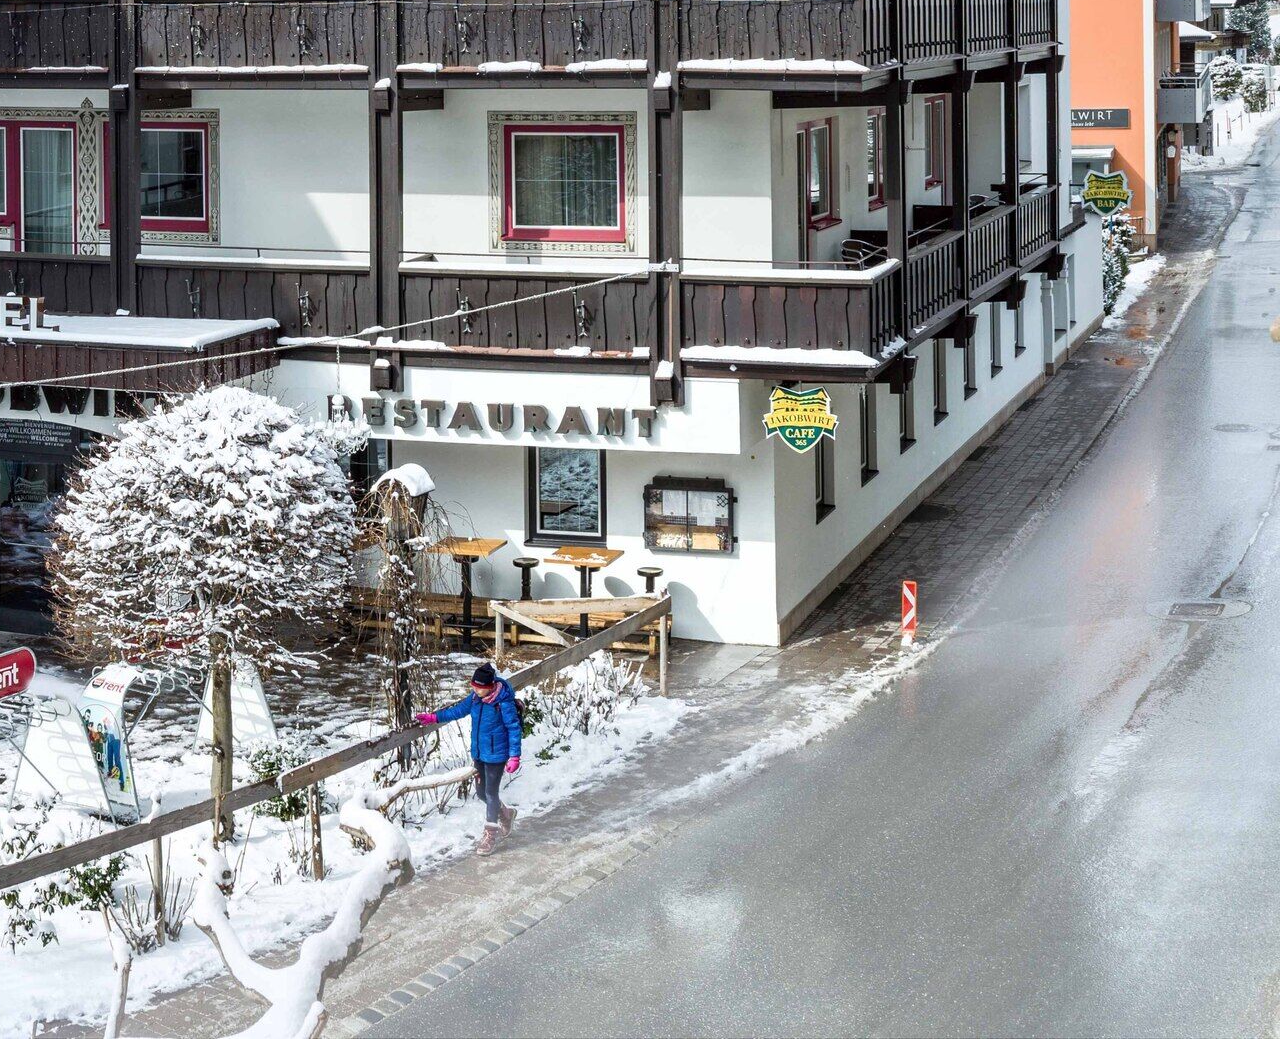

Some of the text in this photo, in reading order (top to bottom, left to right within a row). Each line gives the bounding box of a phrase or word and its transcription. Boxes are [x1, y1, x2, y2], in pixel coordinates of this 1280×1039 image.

[1086, 190, 1126, 198] JAKOBWIRT
[1097, 199, 1116, 208] BAR
[326, 393, 657, 438] RESTAURANT
[770, 414, 833, 426] JAKOBWIRT
[785, 428, 815, 438] CAFE
[103, 680, 126, 694] rent
